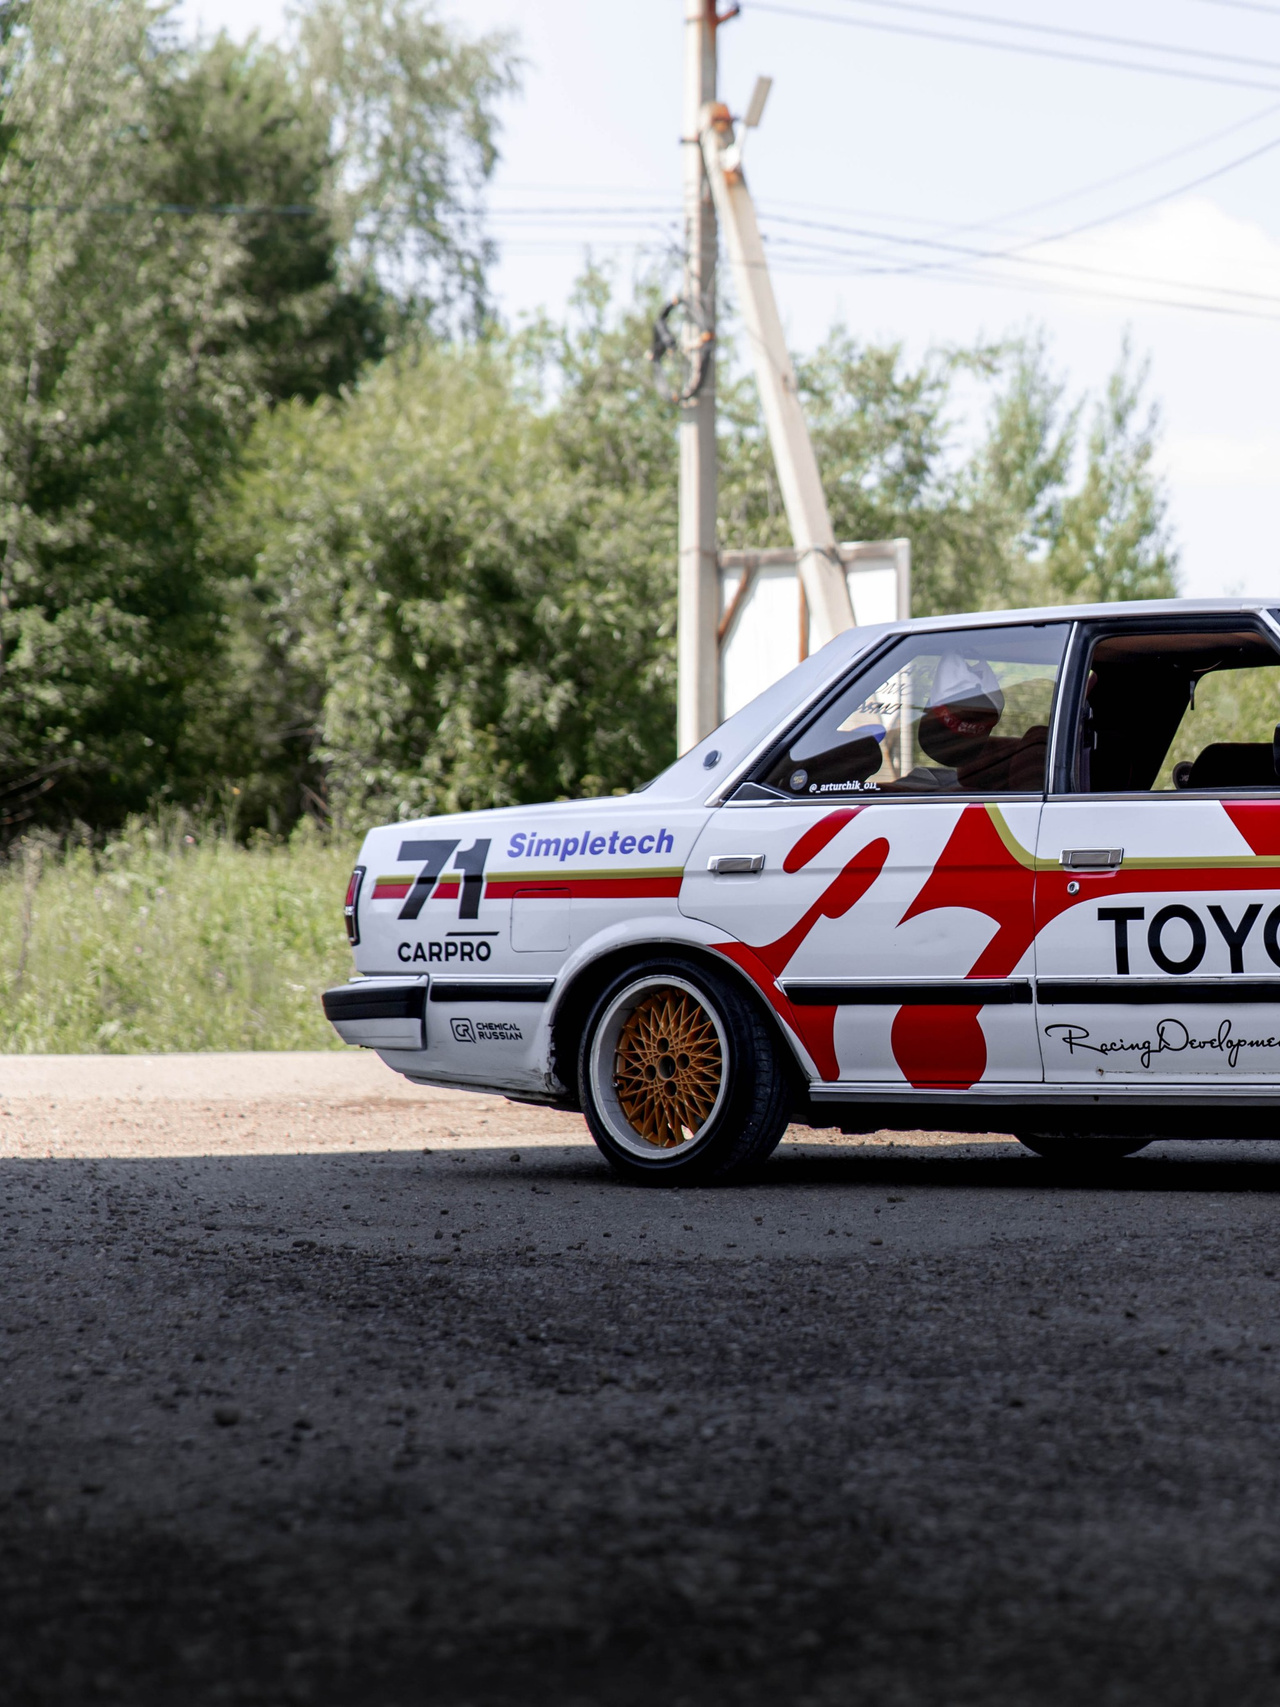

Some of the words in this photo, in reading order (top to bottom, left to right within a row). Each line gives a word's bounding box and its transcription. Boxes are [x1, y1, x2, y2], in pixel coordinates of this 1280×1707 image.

[507, 828, 674, 861] Simpletech
[397, 838, 492, 920] 71
[397, 941, 492, 962] CARPRO
[476, 1022, 520, 1031] CHEMICAL
[478, 1031, 523, 1041] RUSSIAN
[1044, 1023, 1154, 1068] Racing
